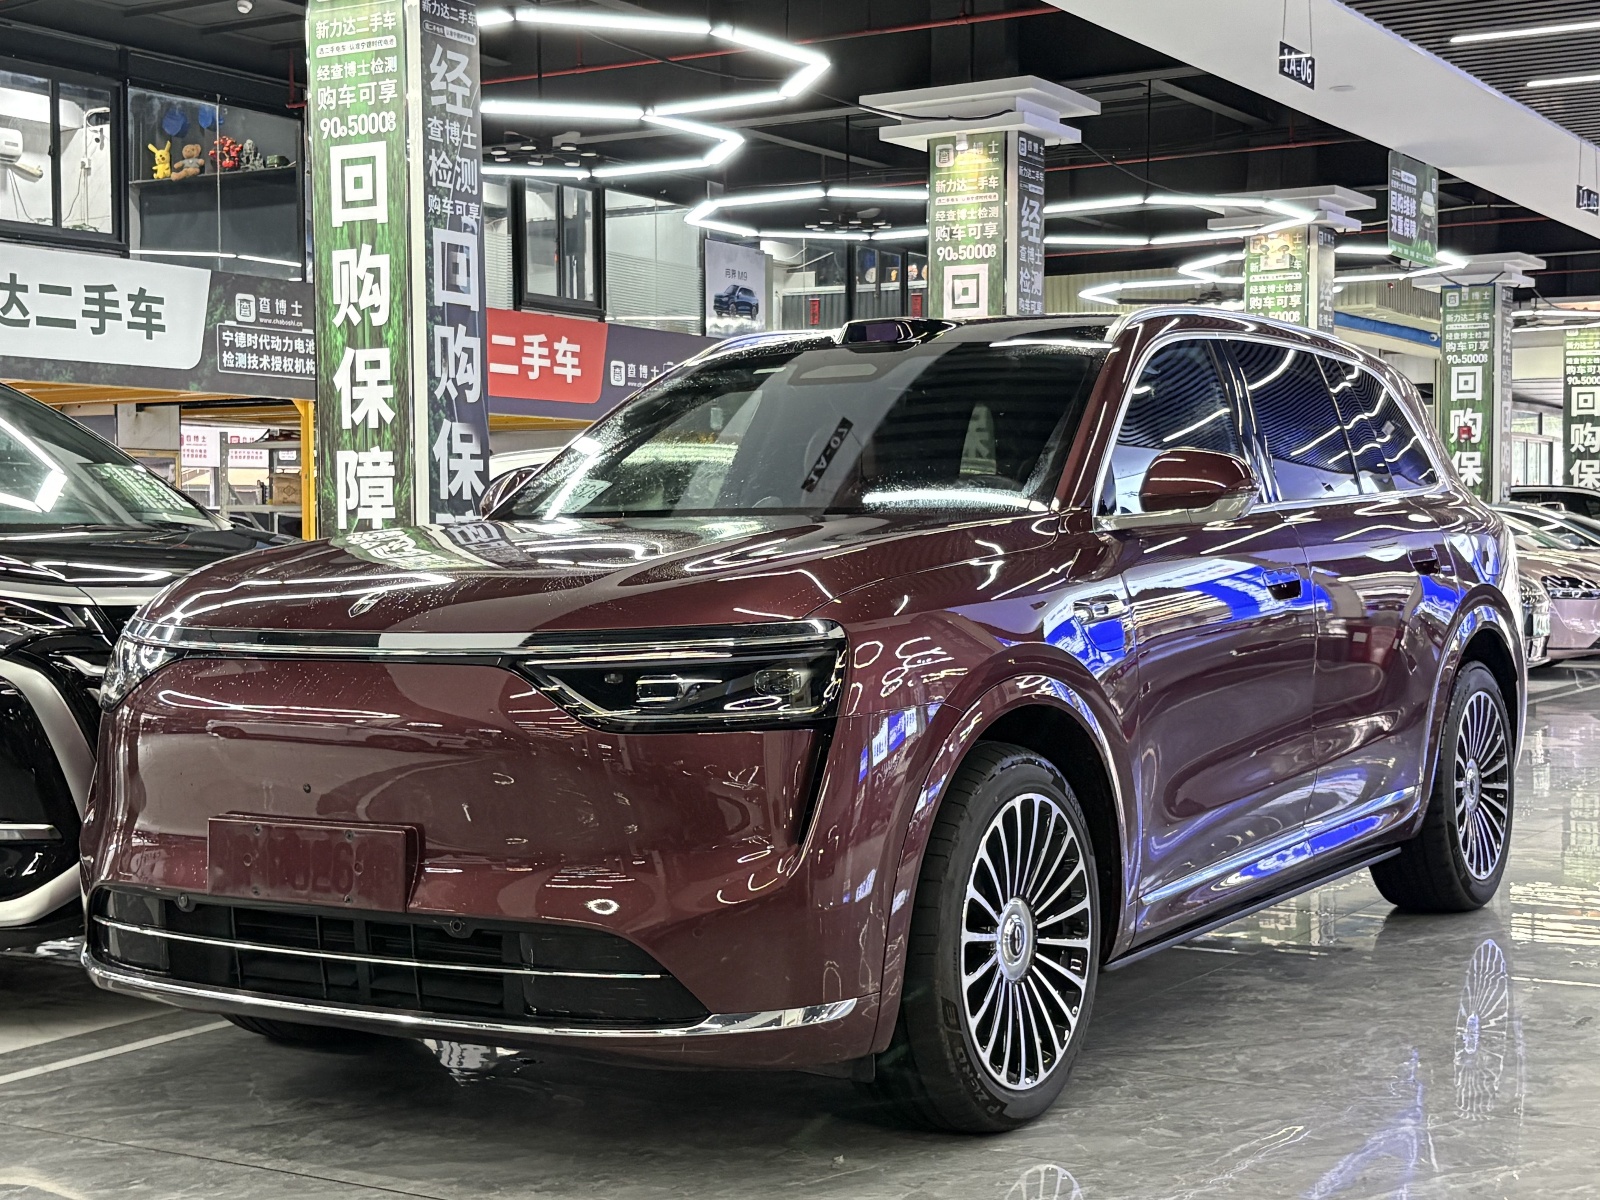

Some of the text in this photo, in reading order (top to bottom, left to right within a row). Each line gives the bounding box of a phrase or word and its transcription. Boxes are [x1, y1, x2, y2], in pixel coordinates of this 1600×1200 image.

[316, 10, 397, 39] 新力达二手车
[421, 0, 477, 27] 新力达二手车
[316, 55, 398, 82] 经查博士检测
[1283, 48, 1312, 84] 1A-06
[430, 43, 473, 118] 经
[317, 78, 398, 112] 购车可享
[427, 115, 477, 150] 查博士
[428, 148, 478, 196] 检测
[935, 174, 999, 193] 新力达二手车
[427, 194, 481, 221] 购车可享
[935, 206, 999, 222] 经查博士检测
[1021, 196, 1041, 244] 经
[935, 222, 999, 242] 购车可享
[944, 263, 988, 317] 回
[1249, 295, 1302, 310] 购车可享
[258, 297, 303, 318] 查博士
[259, 317, 304, 328] www.chaboshi.cn
[330, 140, 396, 530] 回购保障
[222, 330, 315, 355] 宁德时代动力电池
[1446, 341, 1490, 352] 购车可享
[222, 350, 316, 375] 检测技术授权机构
[489, 333, 582, 384] 二手车
[432, 227, 486, 524] 回购保
